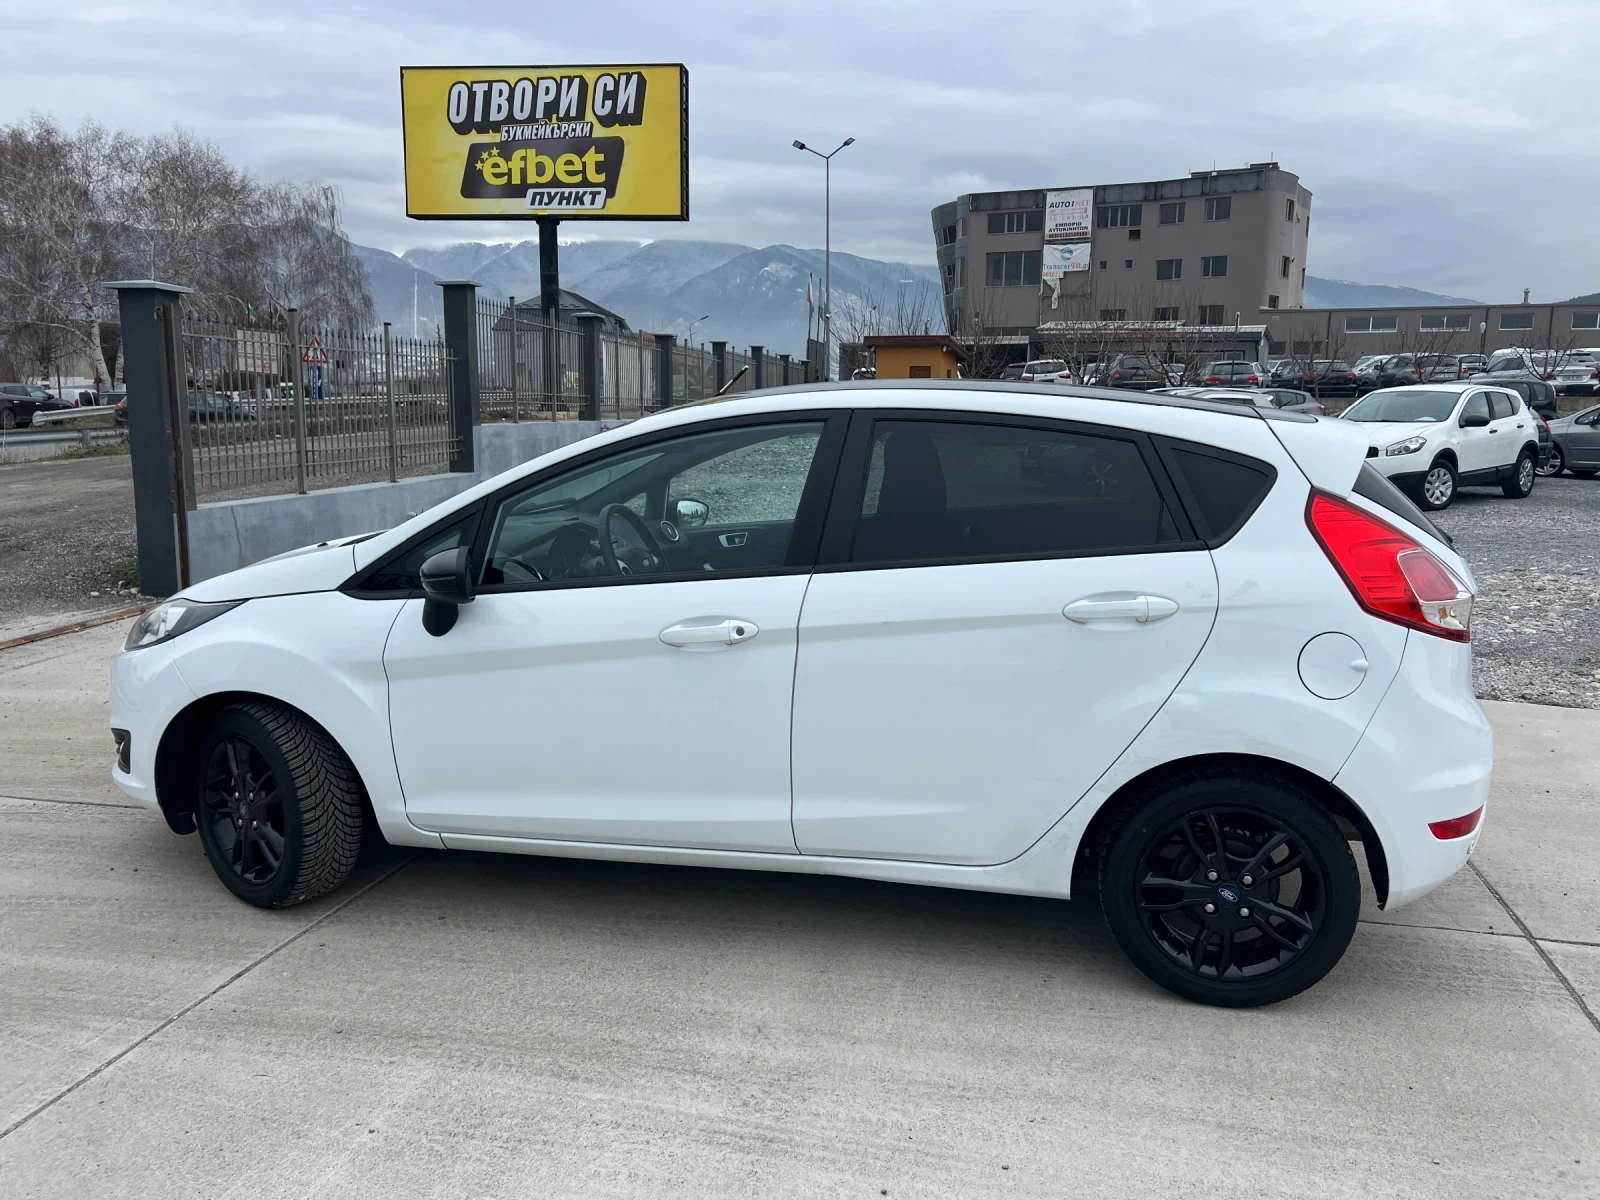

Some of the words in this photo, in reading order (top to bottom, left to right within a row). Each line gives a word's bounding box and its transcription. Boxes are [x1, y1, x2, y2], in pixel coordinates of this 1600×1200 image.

[448, 77, 580, 124] ОТВОРИ
[593, 73, 639, 117] СИ
[501, 121, 592, 142] БУКМЕЙКЪРСКИ
[482, 145, 606, 186] efbet
[530, 191, 602, 207] ПУНКТ
